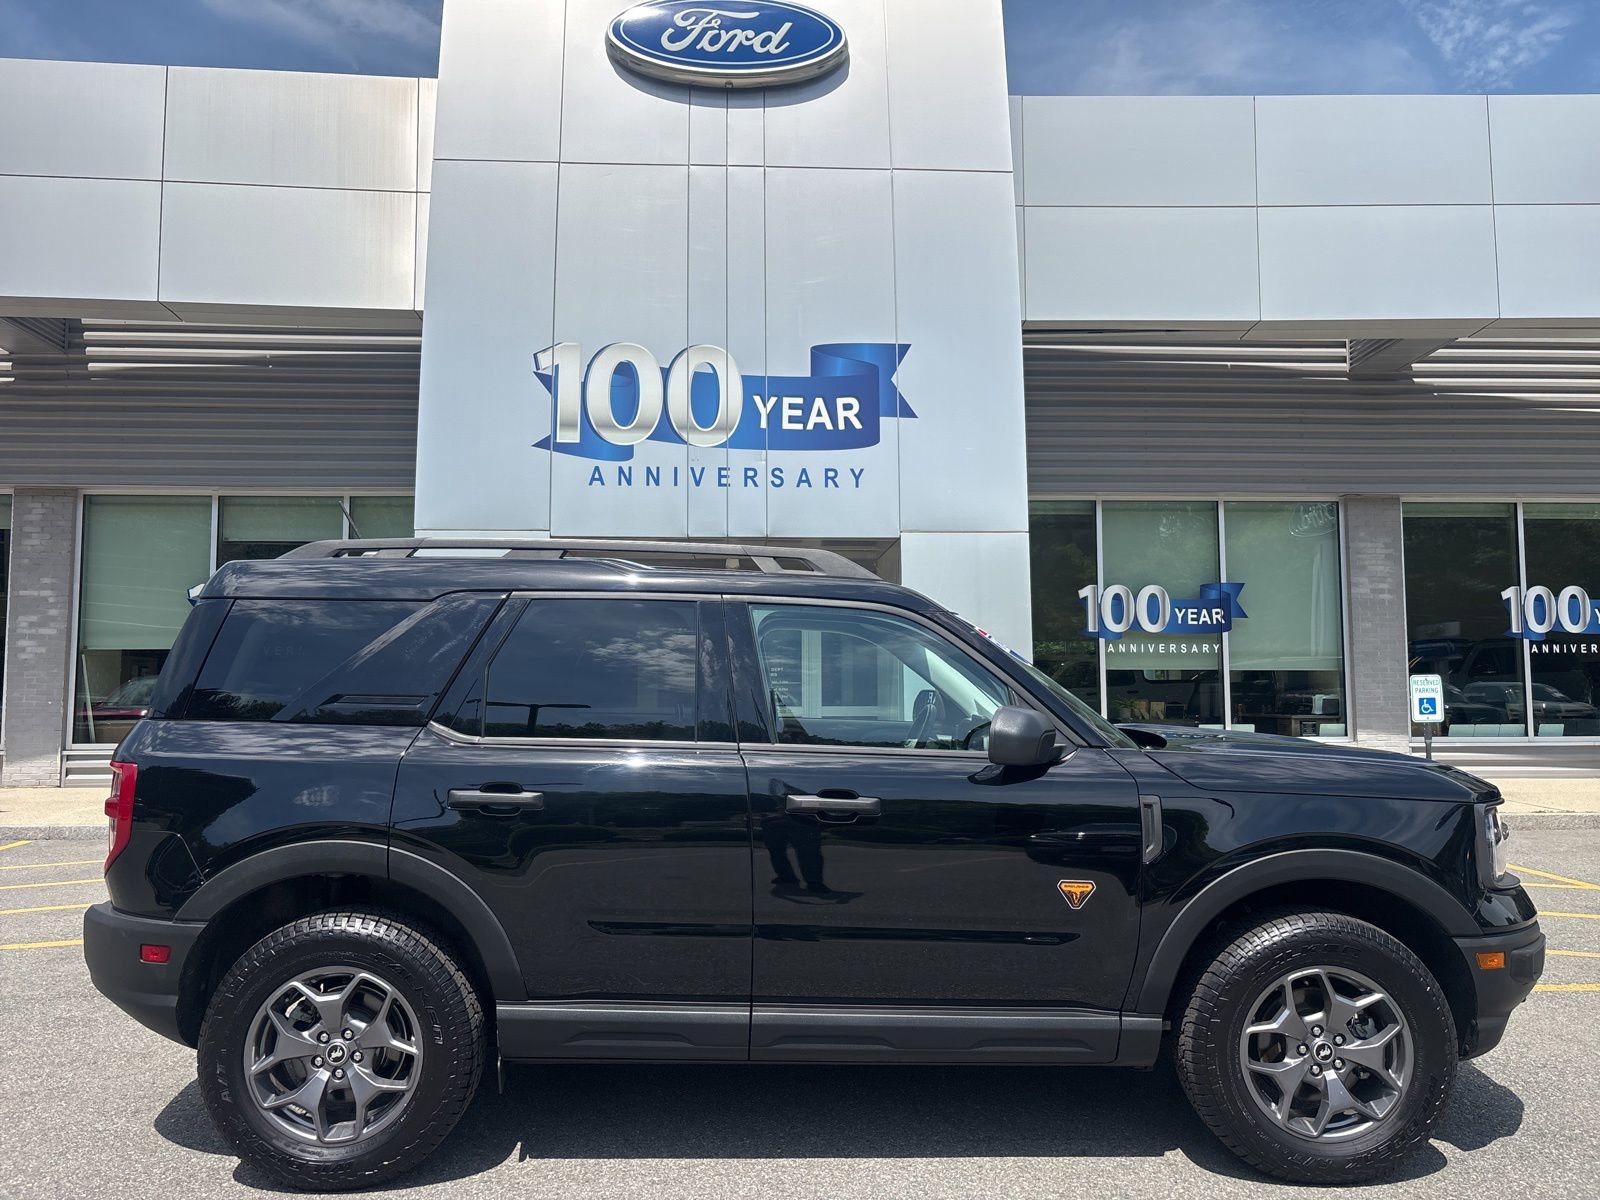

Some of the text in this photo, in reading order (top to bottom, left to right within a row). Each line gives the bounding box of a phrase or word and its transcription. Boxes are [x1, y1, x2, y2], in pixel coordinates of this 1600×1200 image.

[661, 8, 793, 54] Ford
[533, 341, 863, 447] 100 YEAR
[588, 465, 866, 489] ANNIVERSARY
[1078, 584, 1226, 633] 100 YEAR
[1501, 585, 1591, 634] 100
[1107, 643, 1220, 654] ANNIVERSARY
[1412, 679, 1440, 687] RESERVED
